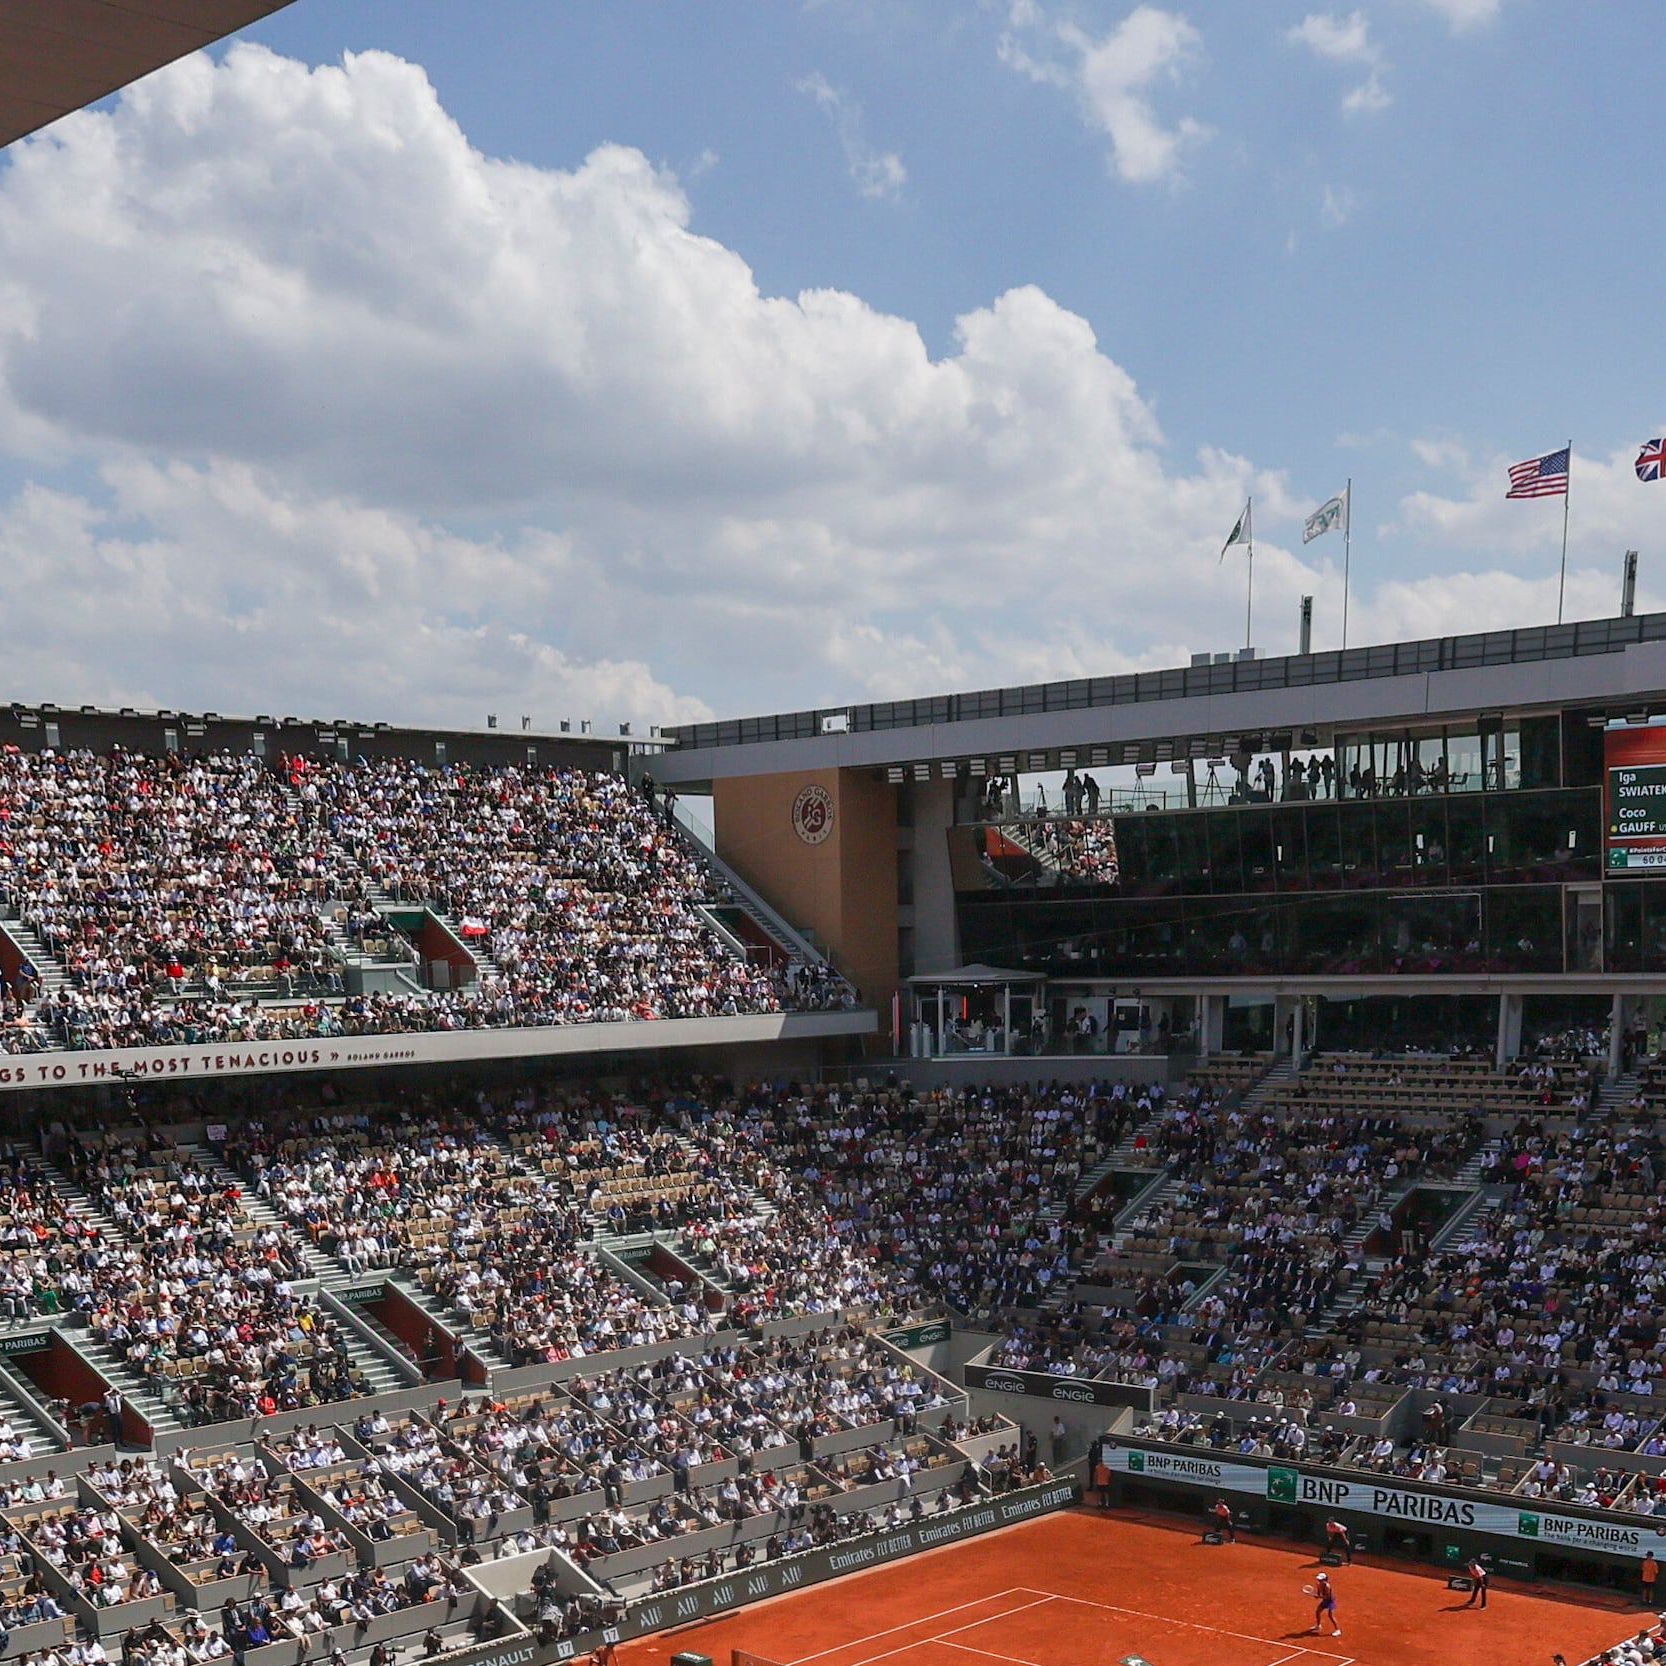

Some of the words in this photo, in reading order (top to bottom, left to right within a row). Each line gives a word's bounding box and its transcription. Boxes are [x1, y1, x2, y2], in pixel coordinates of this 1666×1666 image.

[1619, 772, 1636, 785] Iga
[1619, 808, 1646, 819] Coco
[1619, 821, 1656, 833] GAUFF
[38, 1065, 66, 1081] TO
[79, 1062, 120, 1077] THE
[134, 1057, 191, 1075] MOST
[202, 1050, 320, 1070] TENACIOUS
[5, 1337, 46, 1350] PARIBAS
[1148, 1455, 1171, 1469] BNP
[1173, 1459, 1221, 1477] PARIBAS
[1002, 1496, 1041, 1519] Emirates
[1303, 1478, 1350, 1504] BNP
[1372, 1489, 1475, 1526] PARIBAS
[919, 1521, 961, 1544] Emirates
[962, 1518, 973, 1531] FLY
[974, 1510, 996, 1528] BETTER
[1544, 1518, 1574, 1534] BNP
[1577, 1523, 1639, 1545] PARIBAS
[829, 1547, 874, 1569] Emirates
[877, 1542, 889, 1556] FLY
[889, 1535, 913, 1552] BETTER
[605, 1629, 617, 1641] 17
[559, 1644, 572, 1656] 17
